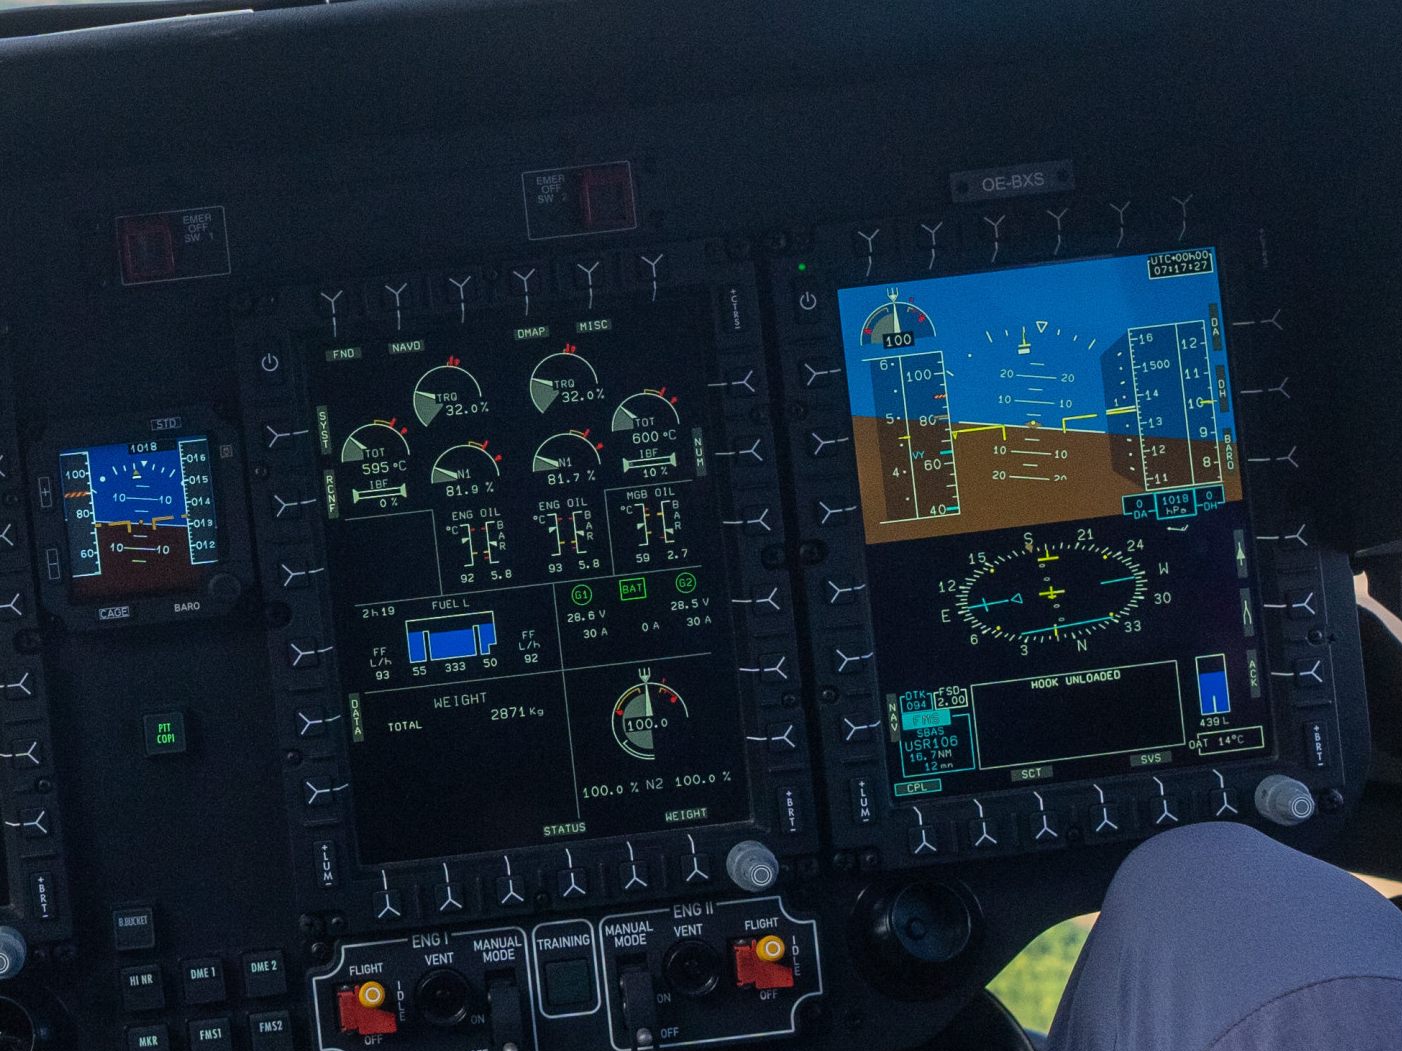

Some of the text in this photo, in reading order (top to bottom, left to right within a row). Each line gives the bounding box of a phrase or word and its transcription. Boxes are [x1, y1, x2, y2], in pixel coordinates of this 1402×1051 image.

[983, 172, 1044, 191] OE-BXS
[183, 213, 211, 224] EMER
[188, 224, 208, 233] OFF
[185, 233, 200, 244] SW
[517, 326, 546, 338] DMAP
[580, 320, 608, 332] MISC
[886, 333, 912, 347] 100
[332, 349, 355, 359] FND
[1141, 359, 1171, 372] 1500
[906, 369, 932, 382] 100
[554, 379, 575, 389] TRQ
[437, 392, 457, 403] TRQ
[157, 419, 176, 429] STD
[635, 417, 655, 428] TOT
[919, 413, 936, 426] 80
[130, 443, 158, 452] 1018
[364, 448, 385, 458] TOT
[924, 458, 941, 471] 60
[65, 470, 85, 479] 100
[548, 472, 580, 485] 81.7
[446, 484, 479, 496] 81.9
[626, 486, 675, 500] MGB OIL
[539, 497, 587, 511] ENG OIL
[1162, 493, 1189, 506] 1018
[76, 509, 89, 519] 80
[452, 507, 499, 522] ENG OIL
[929, 504, 946, 516] 40
[1078, 528, 1094, 541] 21
[1127, 539, 1144, 552] 24
[622, 582, 643, 595] BAT
[432, 599, 459, 610] FUEL
[670, 599, 699, 611] 28.5
[1153, 592, 1171, 605] 30
[99, 607, 128, 619] CAGE
[174, 602, 200, 612] BARO
[567, 611, 595, 623] 28.6
[1124, 620, 1142, 633] 33
[445, 661, 466, 673] 333
[1031, 670, 1121, 689] HOOK UNLOADED
[905, 686, 960, 701] DTK FSD
[433, 692, 487, 709] WEIGHT
[907, 695, 966, 711] 094 2.00
[388, 719, 423, 732] TOTAL
[491, 705, 525, 720] 2871
[158, 723, 171, 733] PTT
[917, 727, 945, 737] SBAS
[904, 736, 959, 752] USR106
[1188, 738, 1208, 750] OAT
[1141, 753, 1161, 764] SVS
[1021, 768, 1042, 779] SCT
[646, 778, 664, 791] N2
[907, 782, 928, 793] CPL
[665, 807, 707, 821] WEIGHT
[543, 822, 586, 836] STATUS
[673, 904, 714, 918] ENG II
[605, 921, 654, 936] MANUAL
[674, 924, 703, 937] VENT
[745, 917, 779, 931] FLIGHT
[412, 933, 448, 949] ENG I
[474, 937, 522, 952] MANUAL
[538, 934, 591, 951] TRAINING
[614, 933, 647, 948] MODE
[425, 952, 454, 965] VENT
[483, 949, 515, 963] MODE
[190, 967, 215, 979] DME 1
[251, 960, 277, 973] DME 2
[349, 963, 383, 976] FLIGHT
[129, 974, 153, 986] HI NR
[760, 990, 778, 1000] OFF
[259, 1021, 283, 1032] FMS2
[660, 1027, 679, 1039] OFF
[200, 1028, 222, 1040] FMS1
[364, 1036, 383, 1045] OFF
[139, 1036, 158, 1047] MKR
